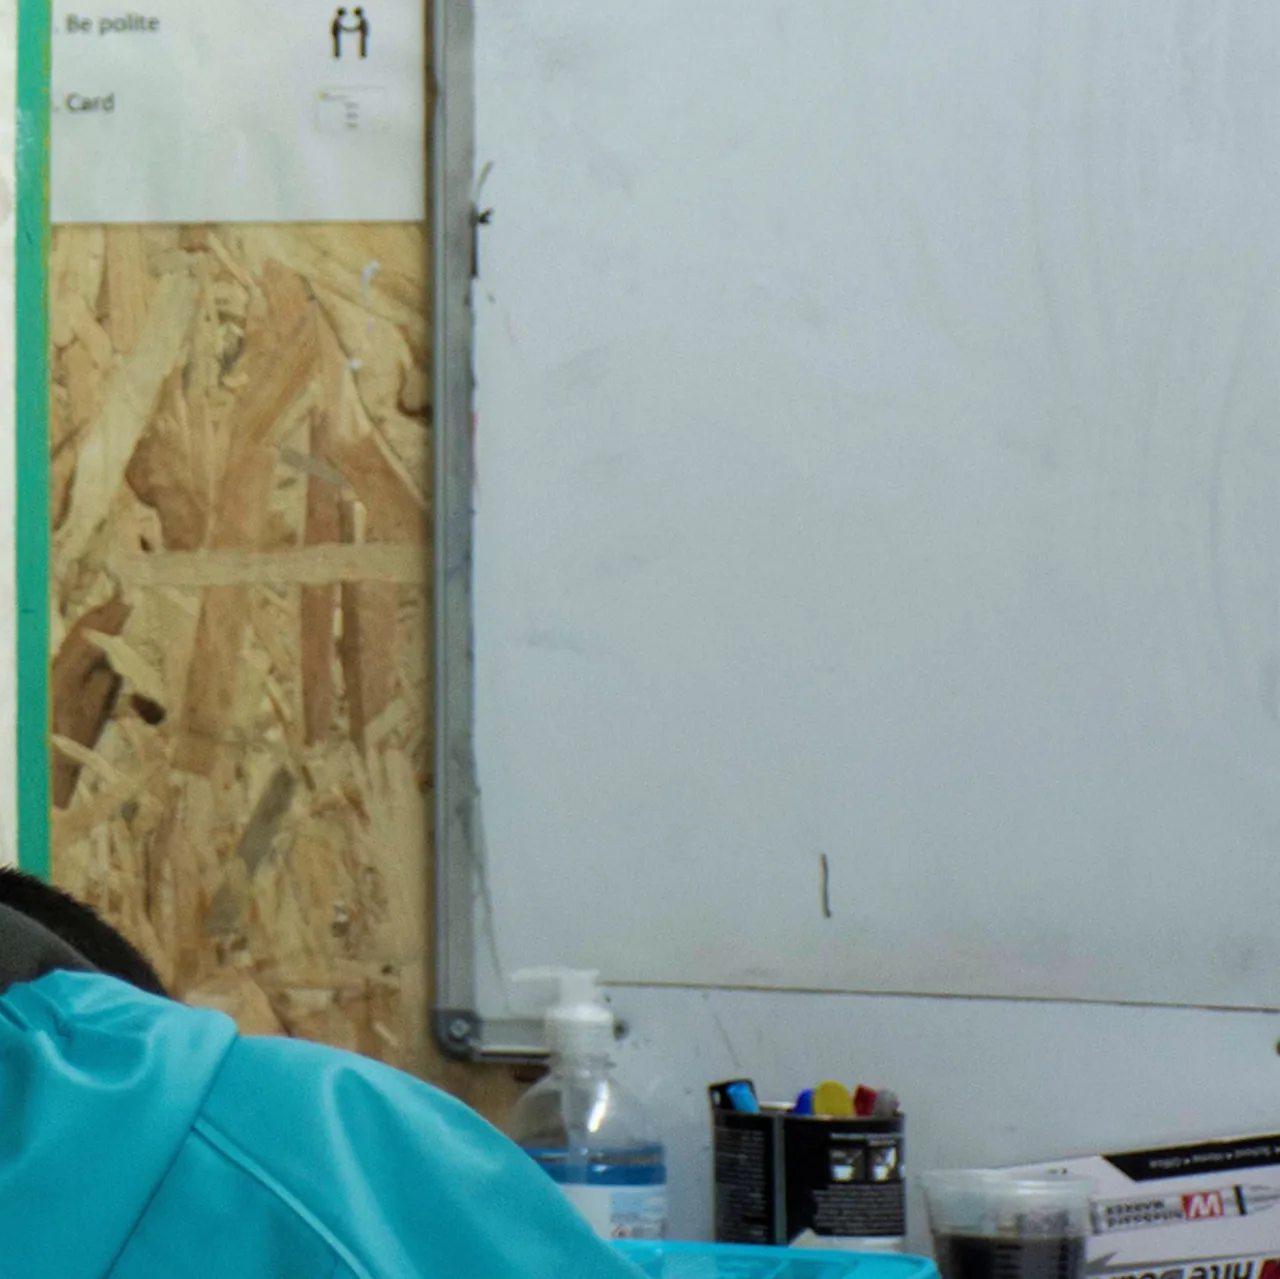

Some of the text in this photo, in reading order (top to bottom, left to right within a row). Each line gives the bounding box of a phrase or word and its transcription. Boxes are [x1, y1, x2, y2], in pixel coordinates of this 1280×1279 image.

[66, 12, 160, 36] Be polite
[66, 93, 115, 114] Card
